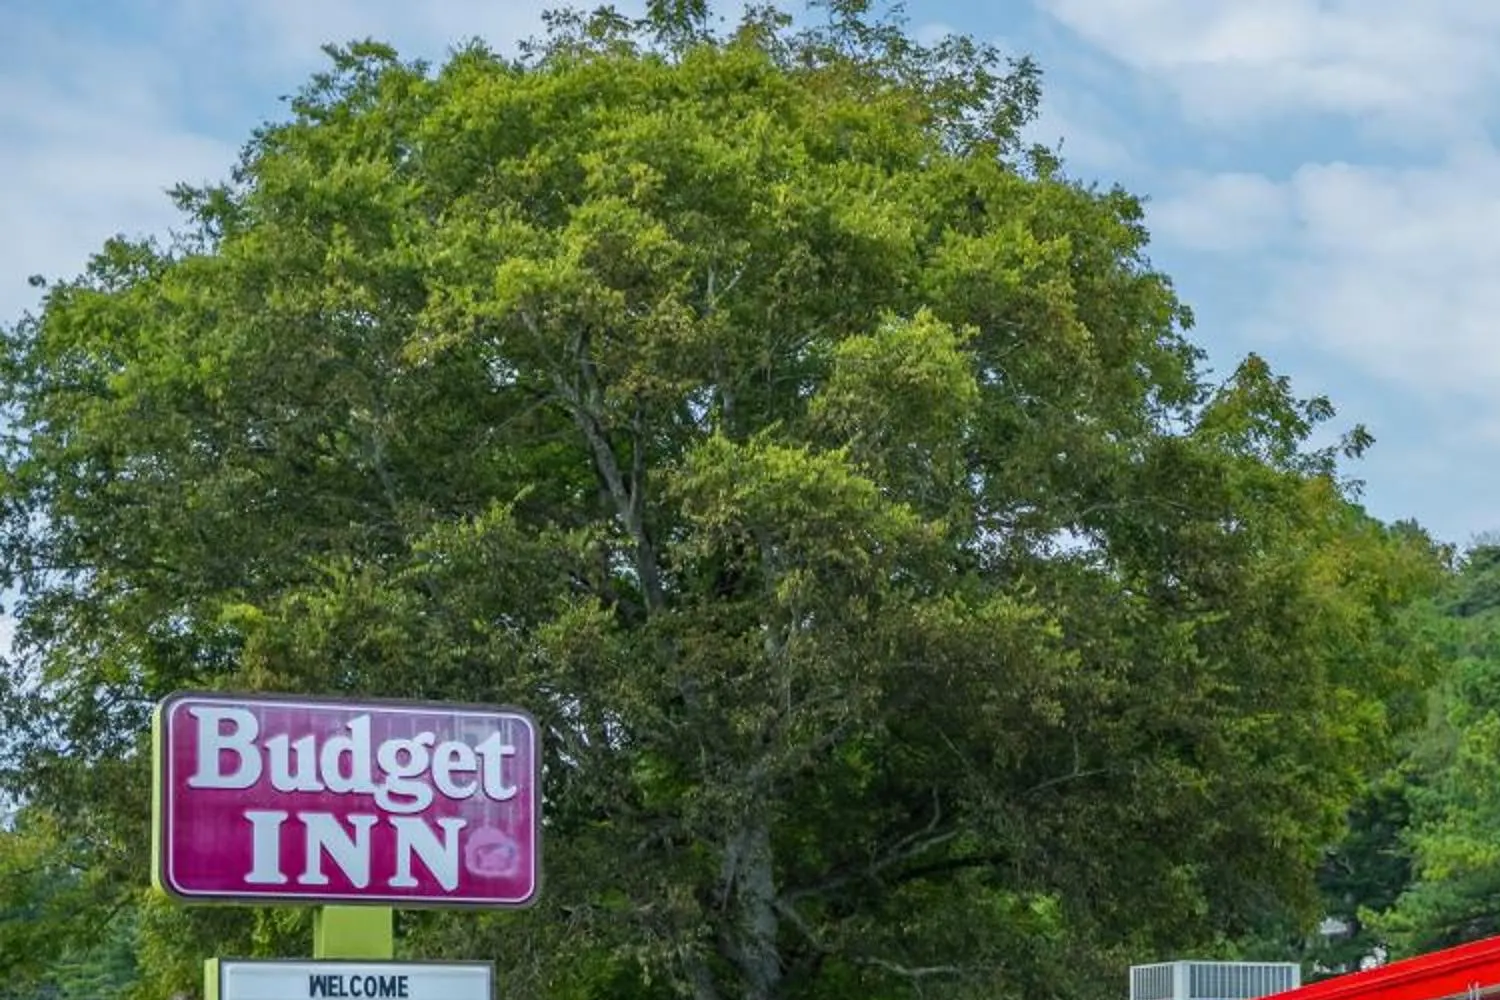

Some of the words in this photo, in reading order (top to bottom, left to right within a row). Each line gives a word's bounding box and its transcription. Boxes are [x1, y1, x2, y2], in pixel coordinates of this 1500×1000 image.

[187, 706, 518, 814] Budget
[244, 811, 467, 893] INN
[308, 975, 409, 999] WELCOME
